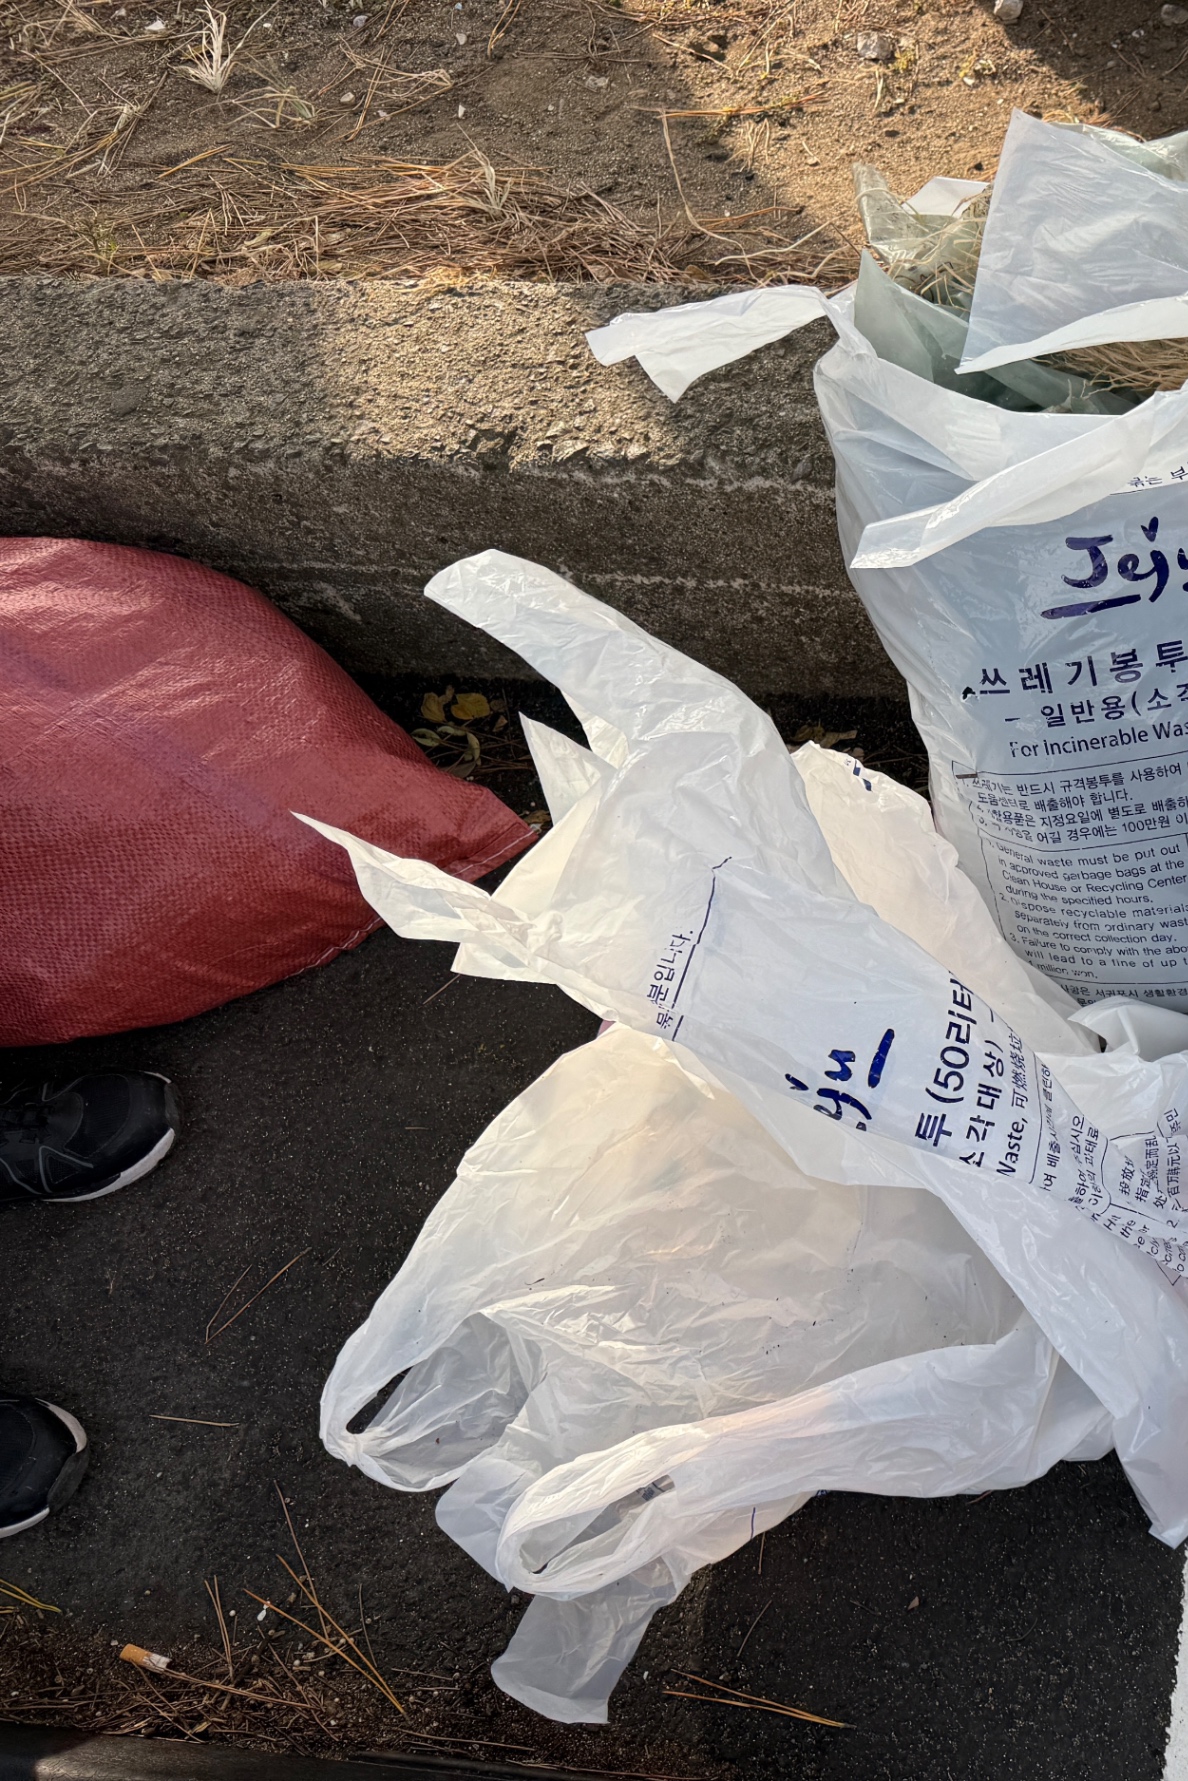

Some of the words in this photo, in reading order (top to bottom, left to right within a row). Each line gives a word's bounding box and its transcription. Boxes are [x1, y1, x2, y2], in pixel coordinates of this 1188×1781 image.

[1042, 726, 1150, 757] Incinerable
[1016, 781, 1056, 797] 반드시
[1060, 771, 1125, 793] 규격봉투를
[1130, 762, 1182, 783] 사용하여
[1034, 795, 1085, 813] 배출해야
[1089, 788, 1133, 805] 합니다.
[1041, 808, 1104, 829] 지정요일에
[1108, 801, 1148, 820] 별도로
[1036, 832, 1062, 845] 어길
[1066, 825, 1118, 842] 경우에는
[1121, 814, 1171, 834] 100만원
[998, 855, 1008, 868] in
[1009, 862, 1058, 879] approved
[1062, 869, 1113, 881] garbage
[1115, 866, 1147, 879] bags
[1149, 863, 1163, 873] at
[1164, 859, 1185, 870] the
[1036, 857, 1073, 868] waste
[1077, 855, 1109, 866] must
[1112, 852, 1129, 863] be
[1134, 847, 1156, 861] put
[1160, 843, 1181, 856] out
[1001, 869, 1031, 886] Clean
[1033, 879, 1068, 893] House
[1070, 884, 1083, 893] or
[1086, 880, 1145, 895] Recycling
[1147, 874, 1188, 889] Center
[1005, 884, 1039, 901] during
[1040, 890, 1058, 902] the
[1061, 895, 1113, 906] specified
[1115, 894, 1154, 905] hours.
[1014, 909, 1069, 929] separately
[1073, 920, 1101, 931] from
[1104, 921, 1155, 933] ordinary
[1060, 908, 1127, 923] recyclable
[1016, 924, 1031, 934] on
[1032, 926, 1050, 937] the
[1053, 931, 1091, 942] correct
[1095, 934, 1148, 944] collection
[1150, 933, 1178, 943] day.
[1021, 936, 1057, 950] Failure
[1059, 940, 1071, 952] to
[1073, 945, 1114, 957] comply
[1117, 946, 1140, 956] with
[1142, 945, 1162, 956] the
[1024, 948, 1045, 959] will
[1049, 952, 1076, 964] lead
[1081, 956, 1094, 966] to
[1098, 959, 1107, 967] a
[1112, 957, 1137, 968] fine
[1142, 958, 1155, 968] of
[1160, 959, 1178, 969] up
[1036, 963, 1069, 975] million
